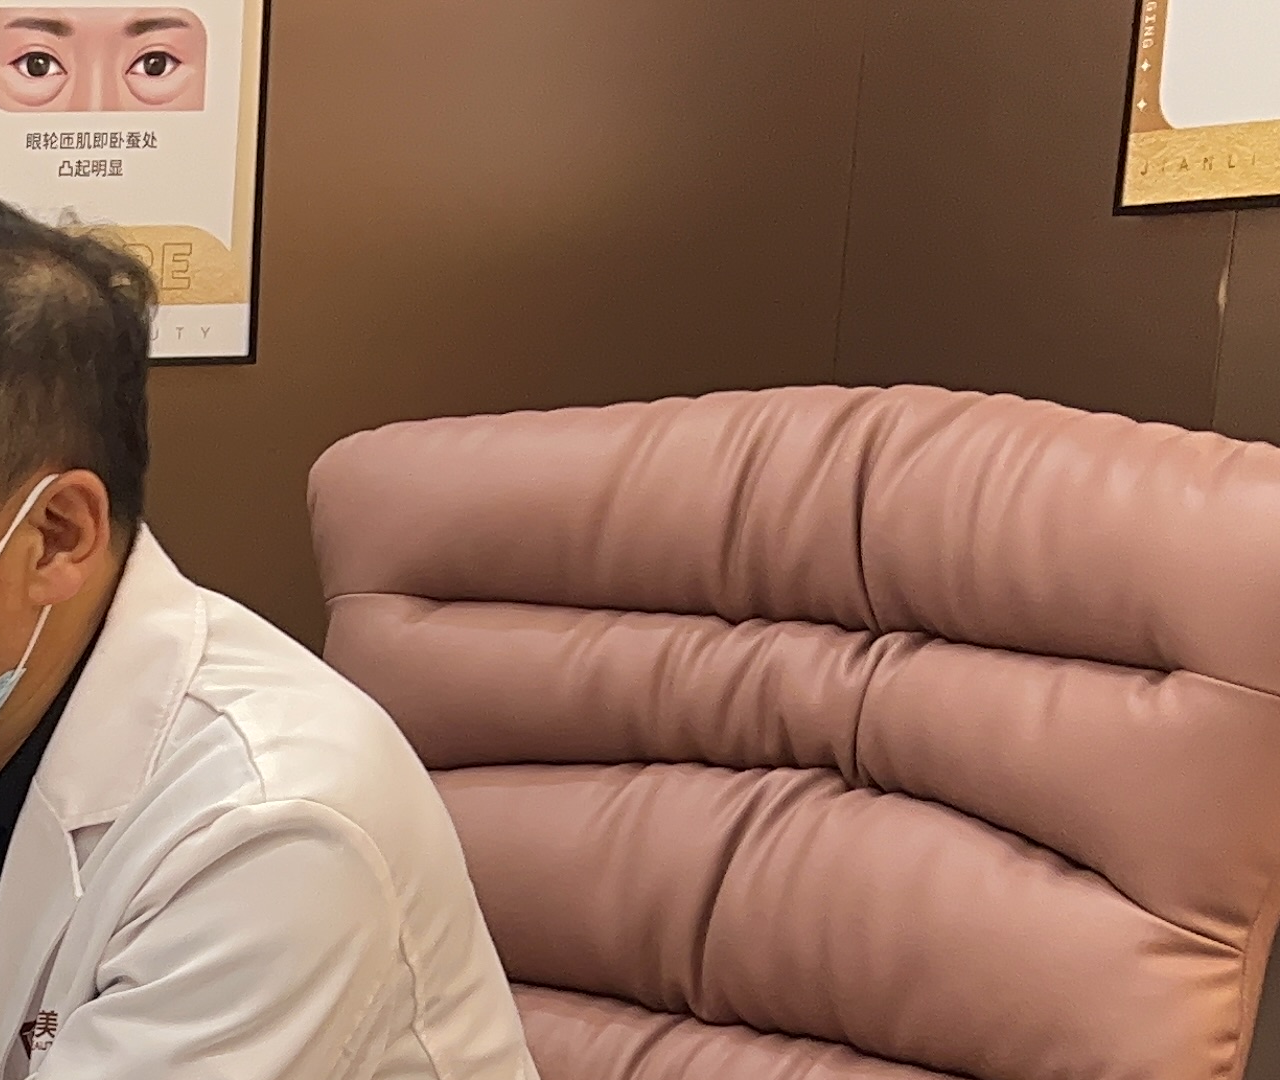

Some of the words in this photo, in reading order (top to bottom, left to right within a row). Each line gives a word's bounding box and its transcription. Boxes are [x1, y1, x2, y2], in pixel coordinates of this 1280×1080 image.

[26, 131, 158, 150] 眼轮匝肌即卧蚕处
[58, 159, 124, 177] 凸起明显
